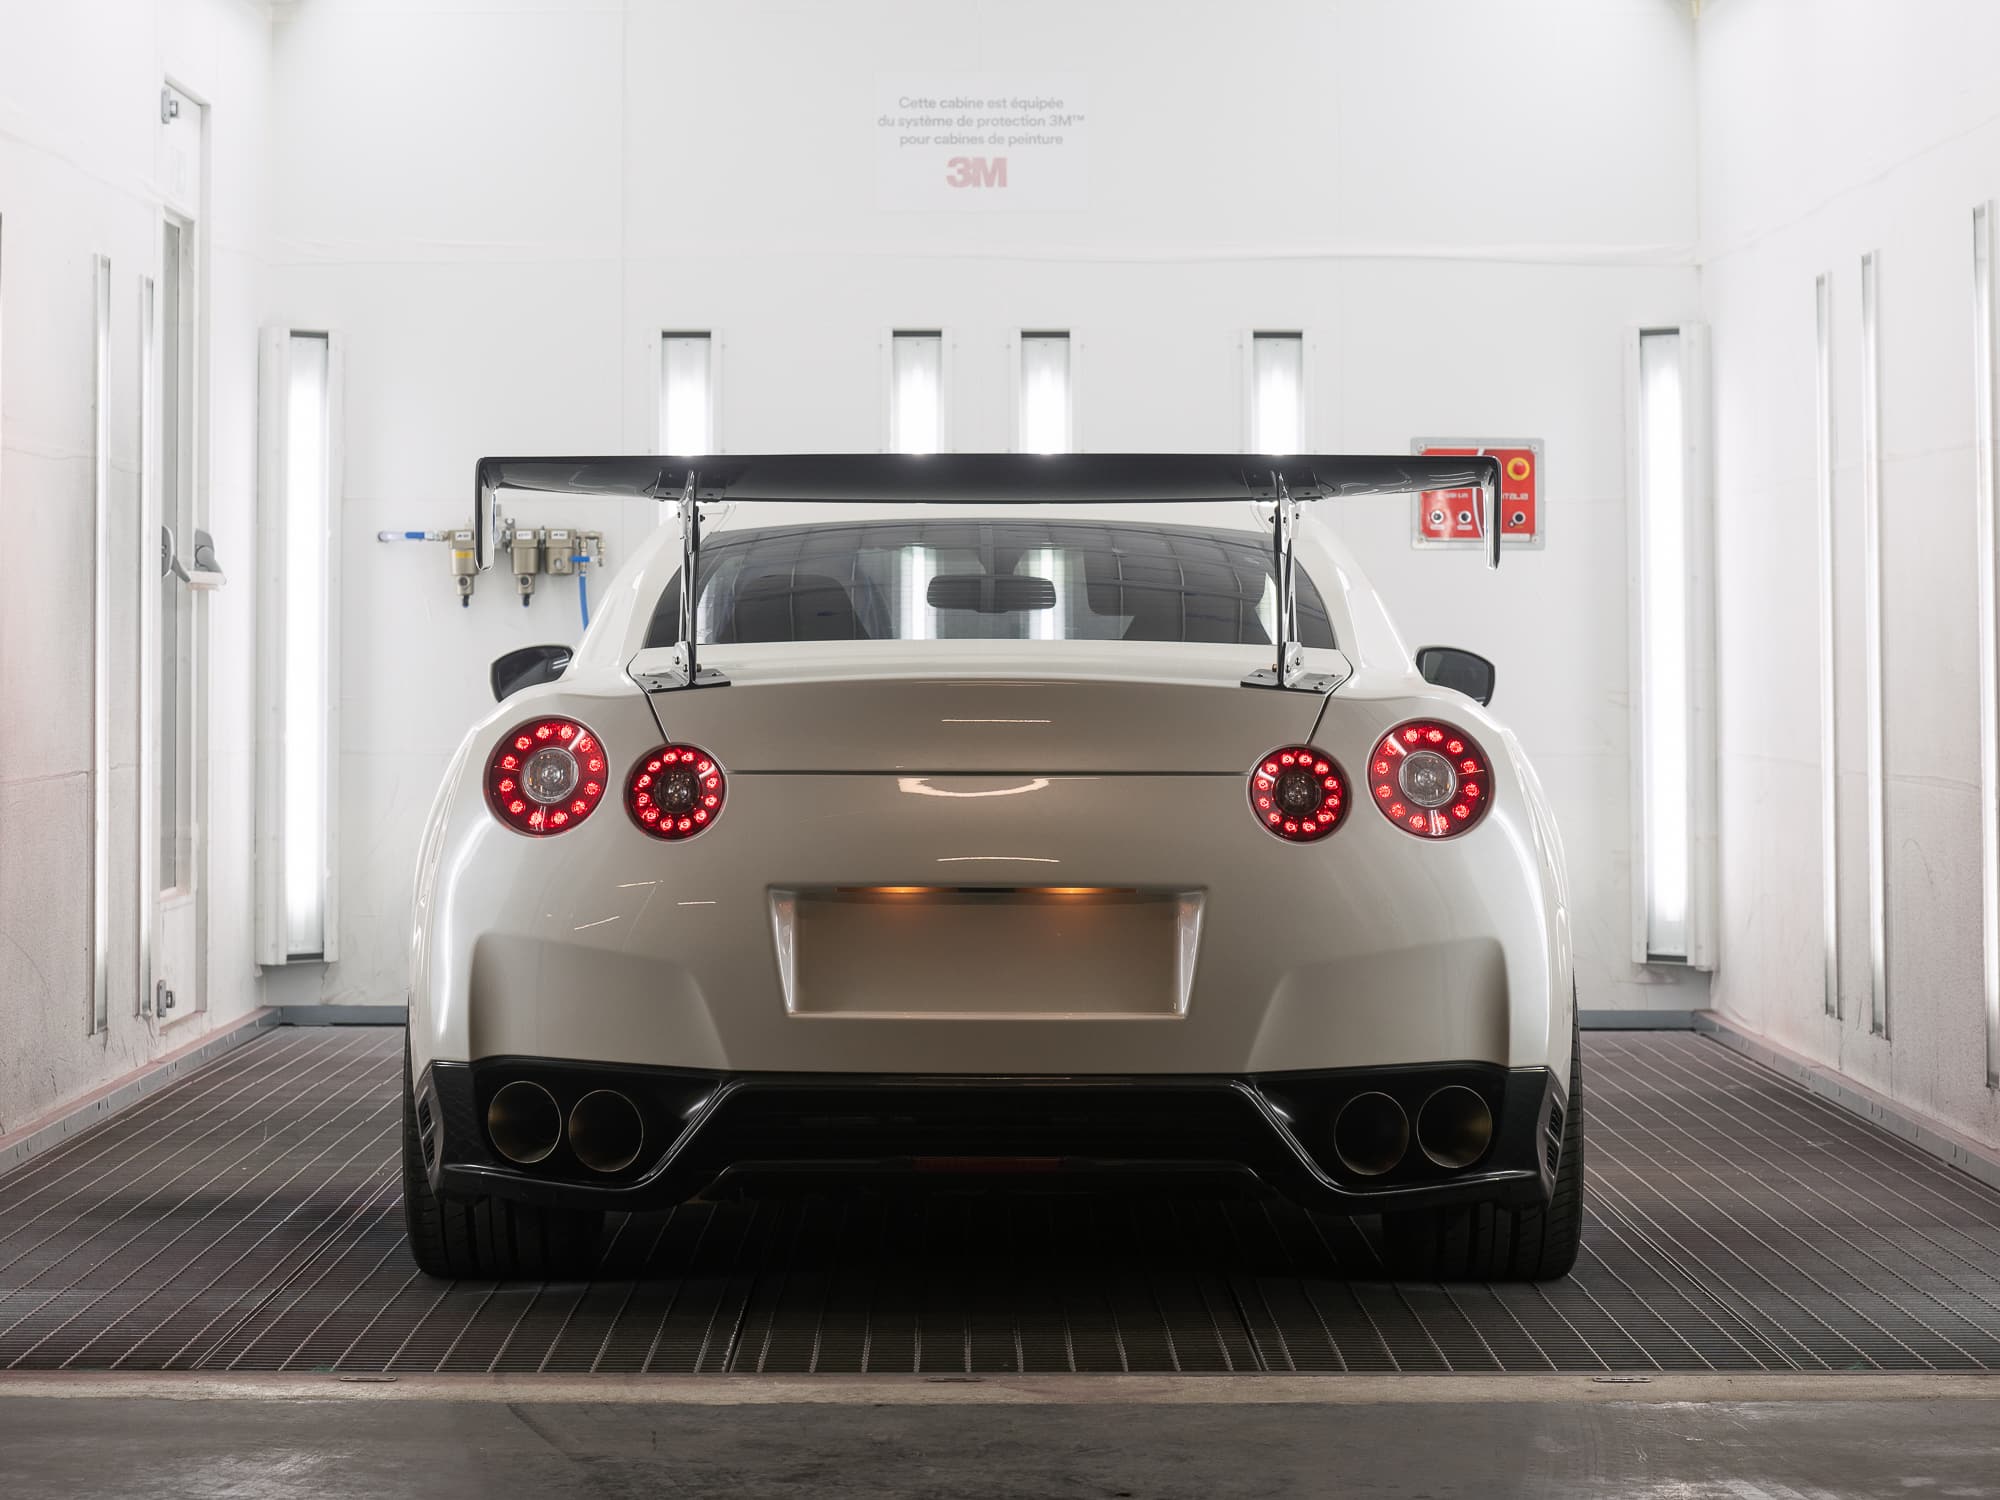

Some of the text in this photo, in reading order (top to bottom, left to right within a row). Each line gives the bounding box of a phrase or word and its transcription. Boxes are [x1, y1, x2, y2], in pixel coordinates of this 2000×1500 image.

[898, 96, 1064, 111] Cette cabine est équipée
[878, 115, 895, 127] du
[898, 115, 953, 129] système
[956, 115, 974, 127] de
[976, 115, 1046, 129] protection
[899, 132, 1063, 148] pour cabines de peinture
[946, 157, 1008, 188] 3M
